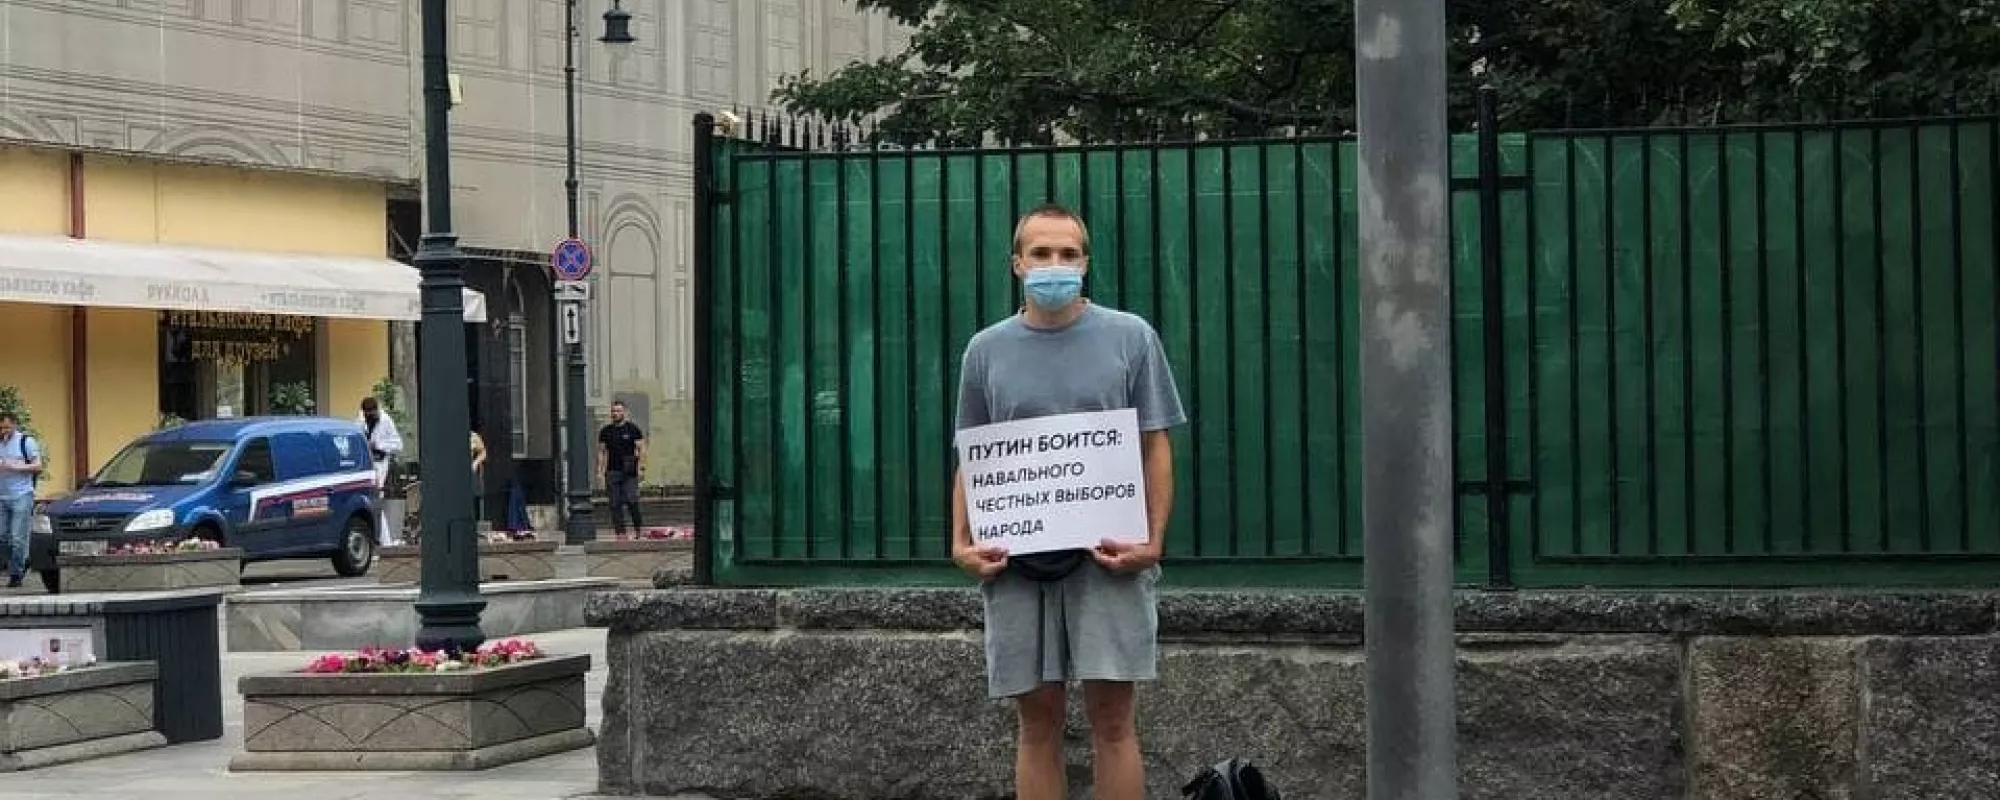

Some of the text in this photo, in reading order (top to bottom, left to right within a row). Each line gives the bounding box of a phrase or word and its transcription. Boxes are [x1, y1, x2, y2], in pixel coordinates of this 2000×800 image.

[968, 429, 1123, 461] ПУТИН БОИТСЯ:
[973, 461, 1085, 488] НАВАЛЬНОГО
[976, 483, 1136, 513] ЧЕСТНЫХ ВЫБОРОВ
[979, 519, 1044, 539] НАРОДА
